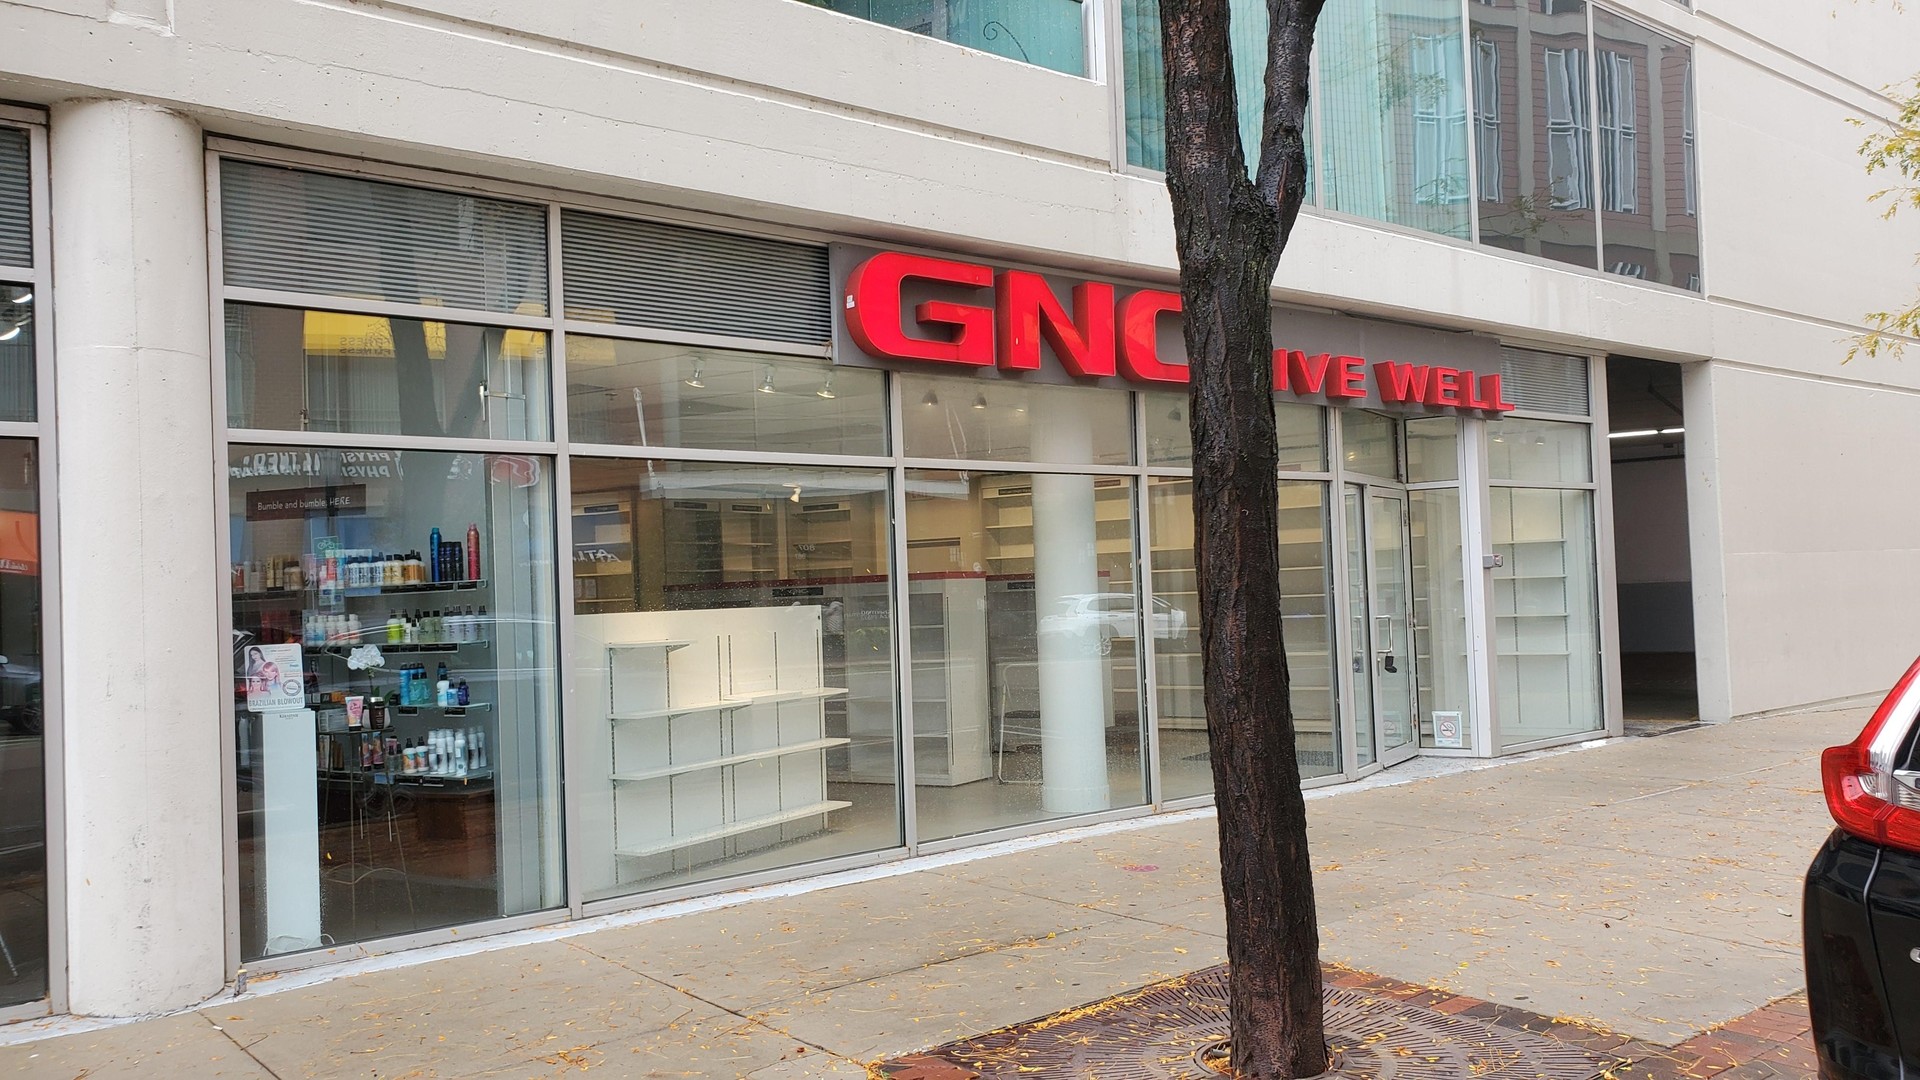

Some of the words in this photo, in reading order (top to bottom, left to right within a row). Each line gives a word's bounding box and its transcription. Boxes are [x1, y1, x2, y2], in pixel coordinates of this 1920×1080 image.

[844, 251, 1190, 383] GNC
[1271, 348, 1367, 399] IVE
[1373, 360, 1515, 412] WELL
[257, 501, 283, 511] Bumble
[284, 500, 297, 509] and
[330, 496, 351, 506] HERE
[249, 699, 276, 707] BRAZILIAN
[277, 697, 303, 706] BLOWOUT
